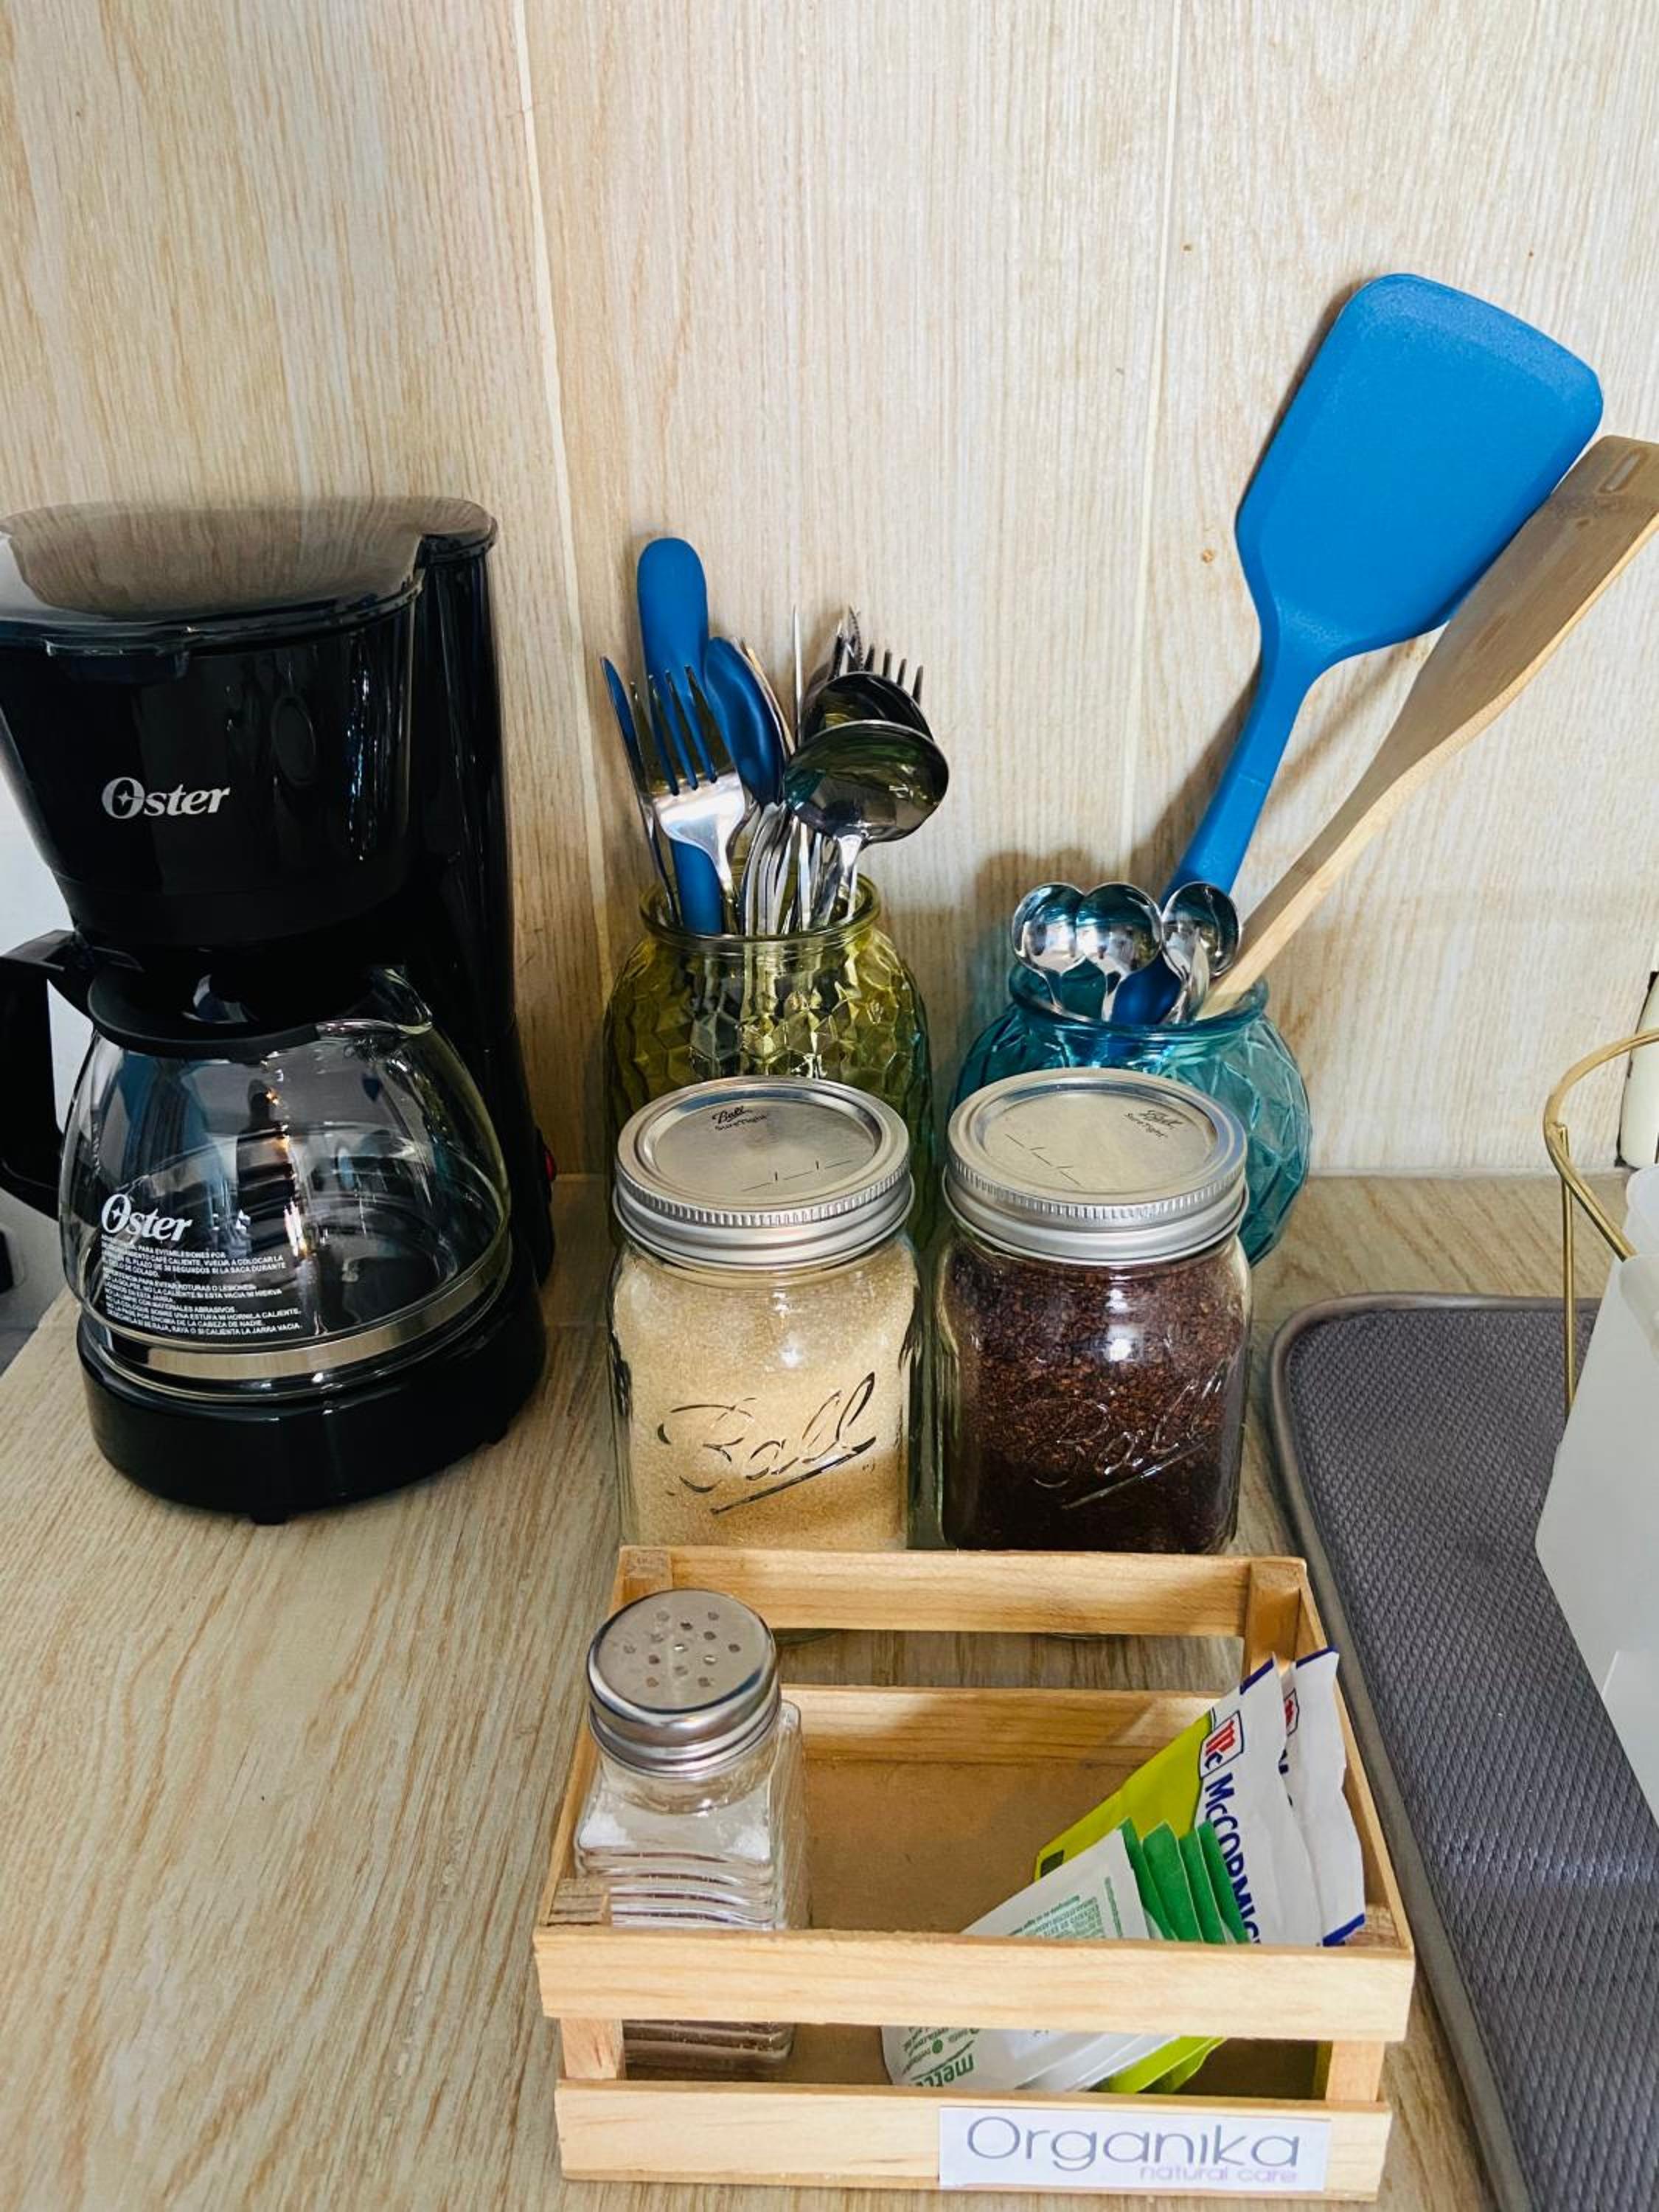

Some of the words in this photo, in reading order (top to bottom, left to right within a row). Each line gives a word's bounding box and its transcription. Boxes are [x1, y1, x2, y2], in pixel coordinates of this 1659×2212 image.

[102, 777, 231, 819] Oster
[102, 1194, 193, 1242] Oster
[274, 1254, 284, 1262] LA
[241, 1326, 251, 1335] LA
[657, 1371, 876, 1504] Ball
[967, 2116, 1300, 2171] Organika
[1140, 2165, 1228, 2182] natural
[1238, 2168, 1297, 2183] care
